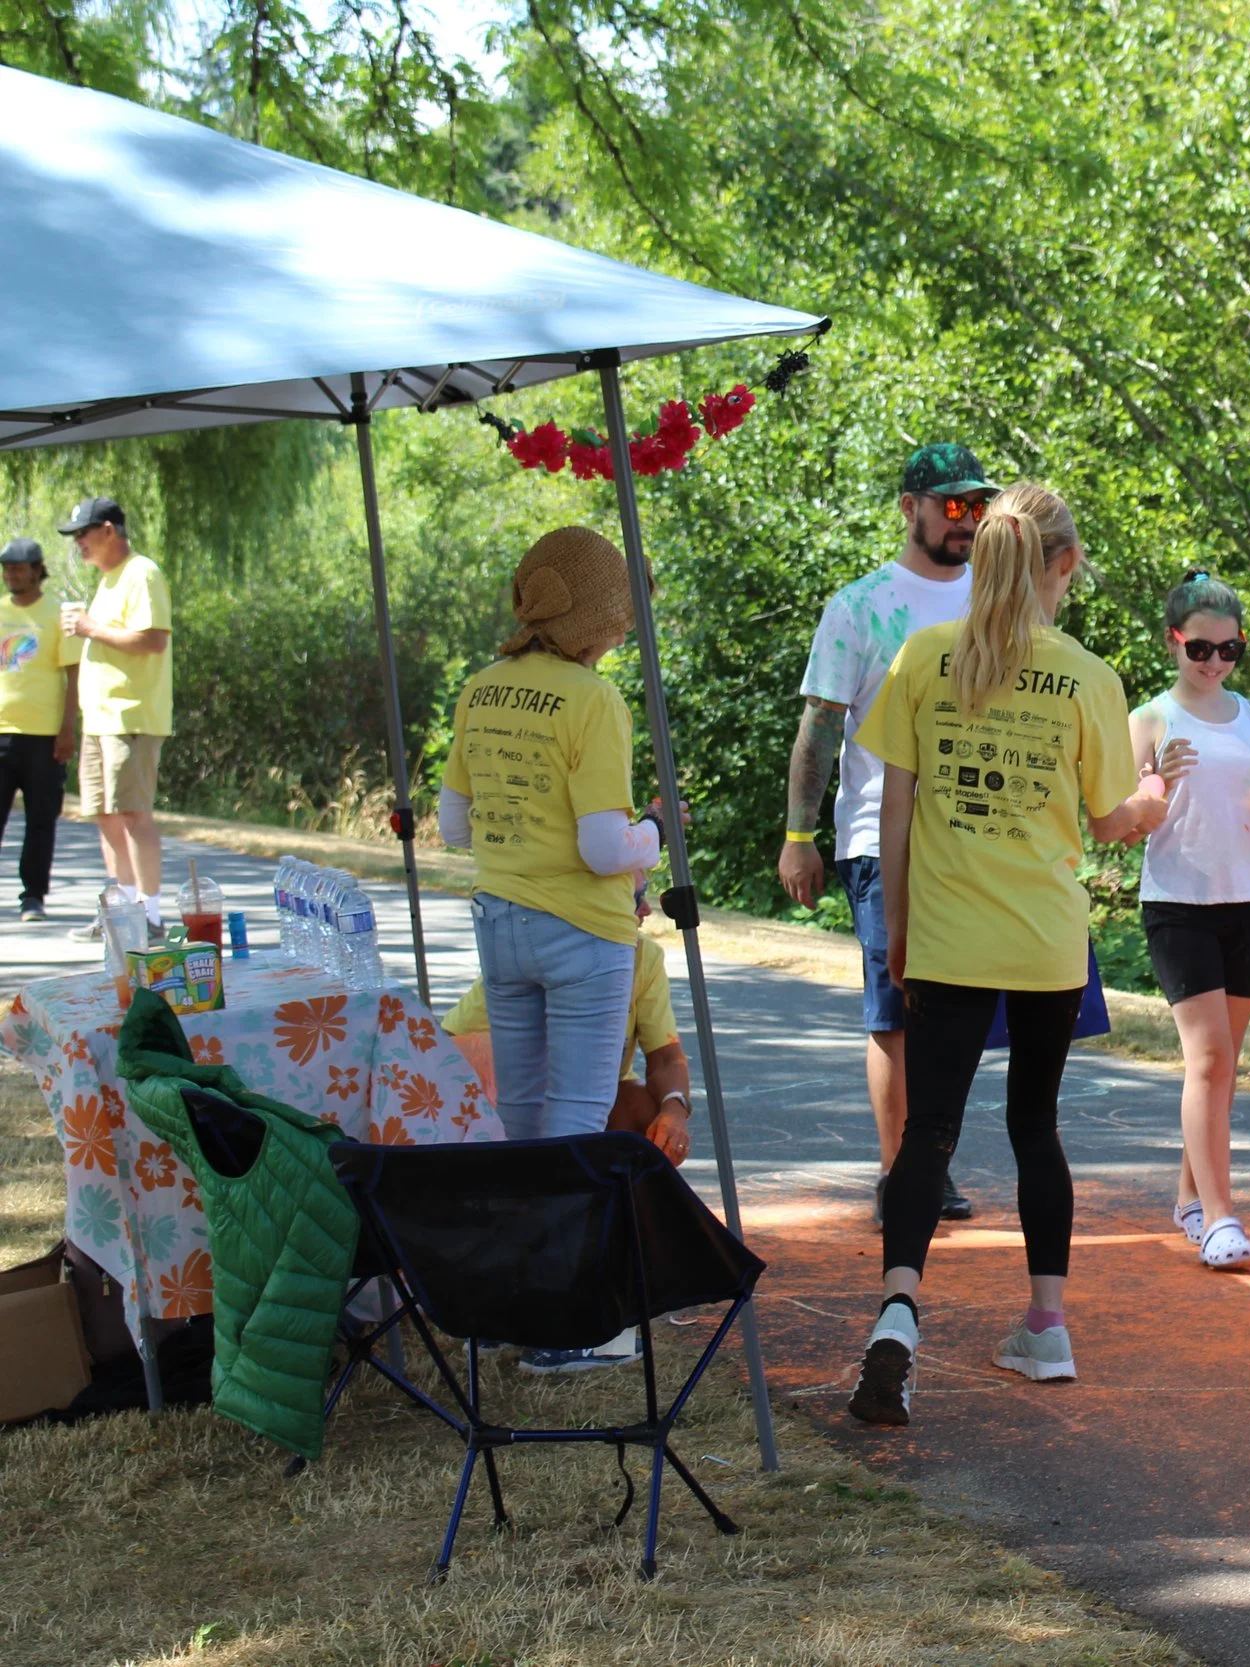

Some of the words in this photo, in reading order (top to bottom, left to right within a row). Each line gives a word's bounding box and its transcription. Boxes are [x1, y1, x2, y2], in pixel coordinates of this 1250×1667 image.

[1015, 669, 1080, 699] STAFF
[468, 685, 514, 708] EVENT
[510, 688, 566, 716] STAFF
[956, 790, 984, 799] staples
[188, 959, 215, 969] CHALK
[190, 968, 215, 978] CRAIE
